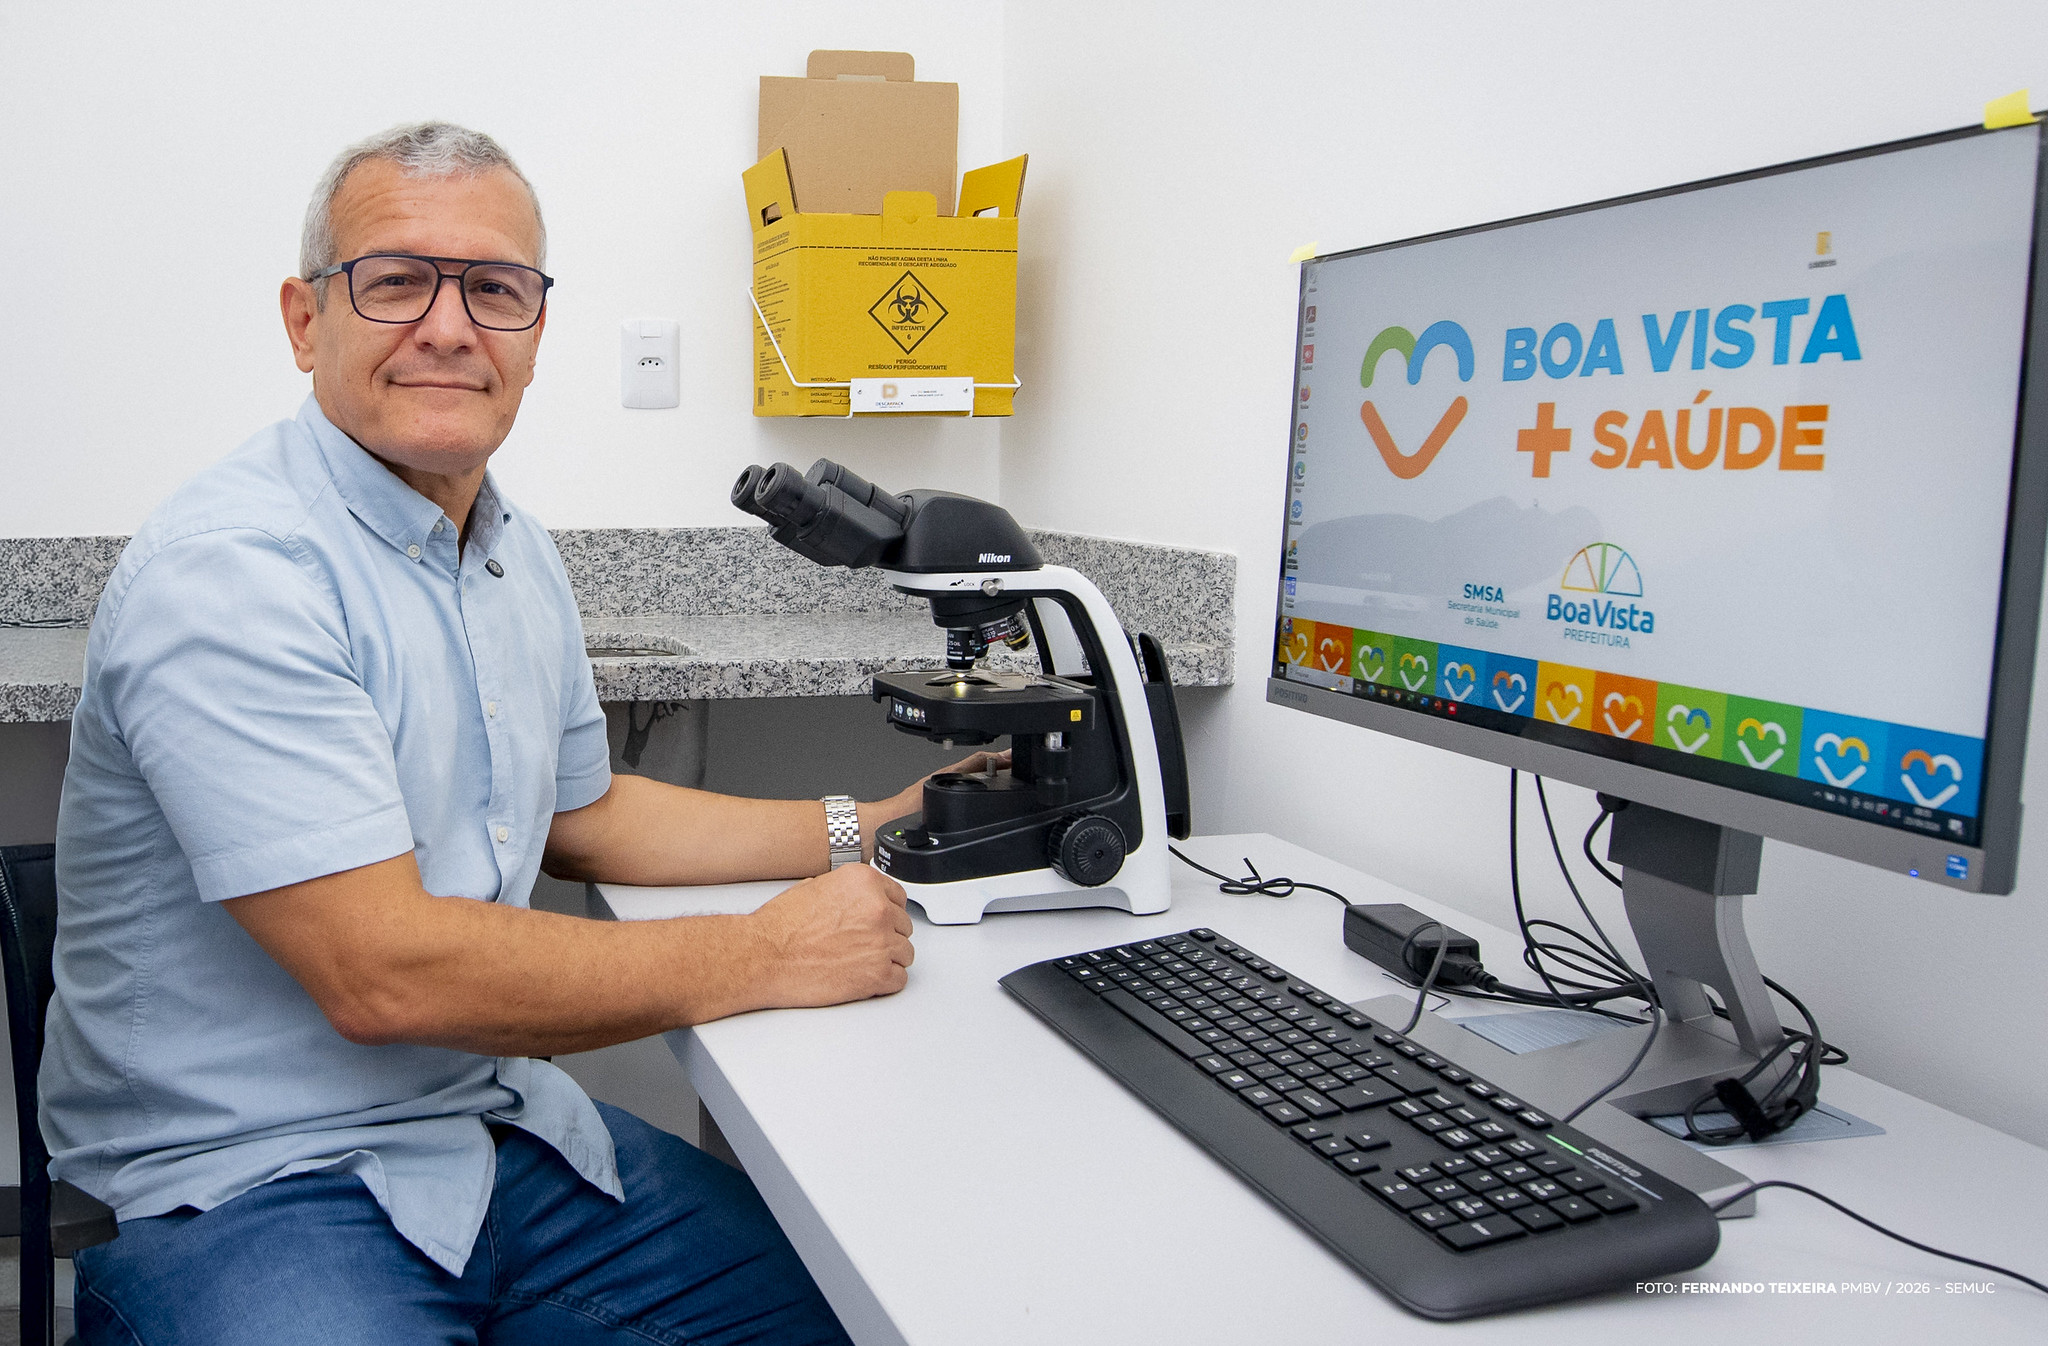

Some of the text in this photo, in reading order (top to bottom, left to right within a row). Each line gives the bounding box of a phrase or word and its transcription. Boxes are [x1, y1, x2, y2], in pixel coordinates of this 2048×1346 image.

[1502, 294, 1862, 382] BOA VISTA
[1517, 389, 1830, 478] + SAÚDE
[978, 553, 1011, 563] Nikon
[1463, 583, 1505, 604] SMSA
[1448, 600, 1520, 619] Secretaria Municipal
[1464, 616, 1500, 630] de Saúde
[1563, 628, 1632, 649] PREFEITURA
[1274, 688, 1308, 703] POSITIVO
